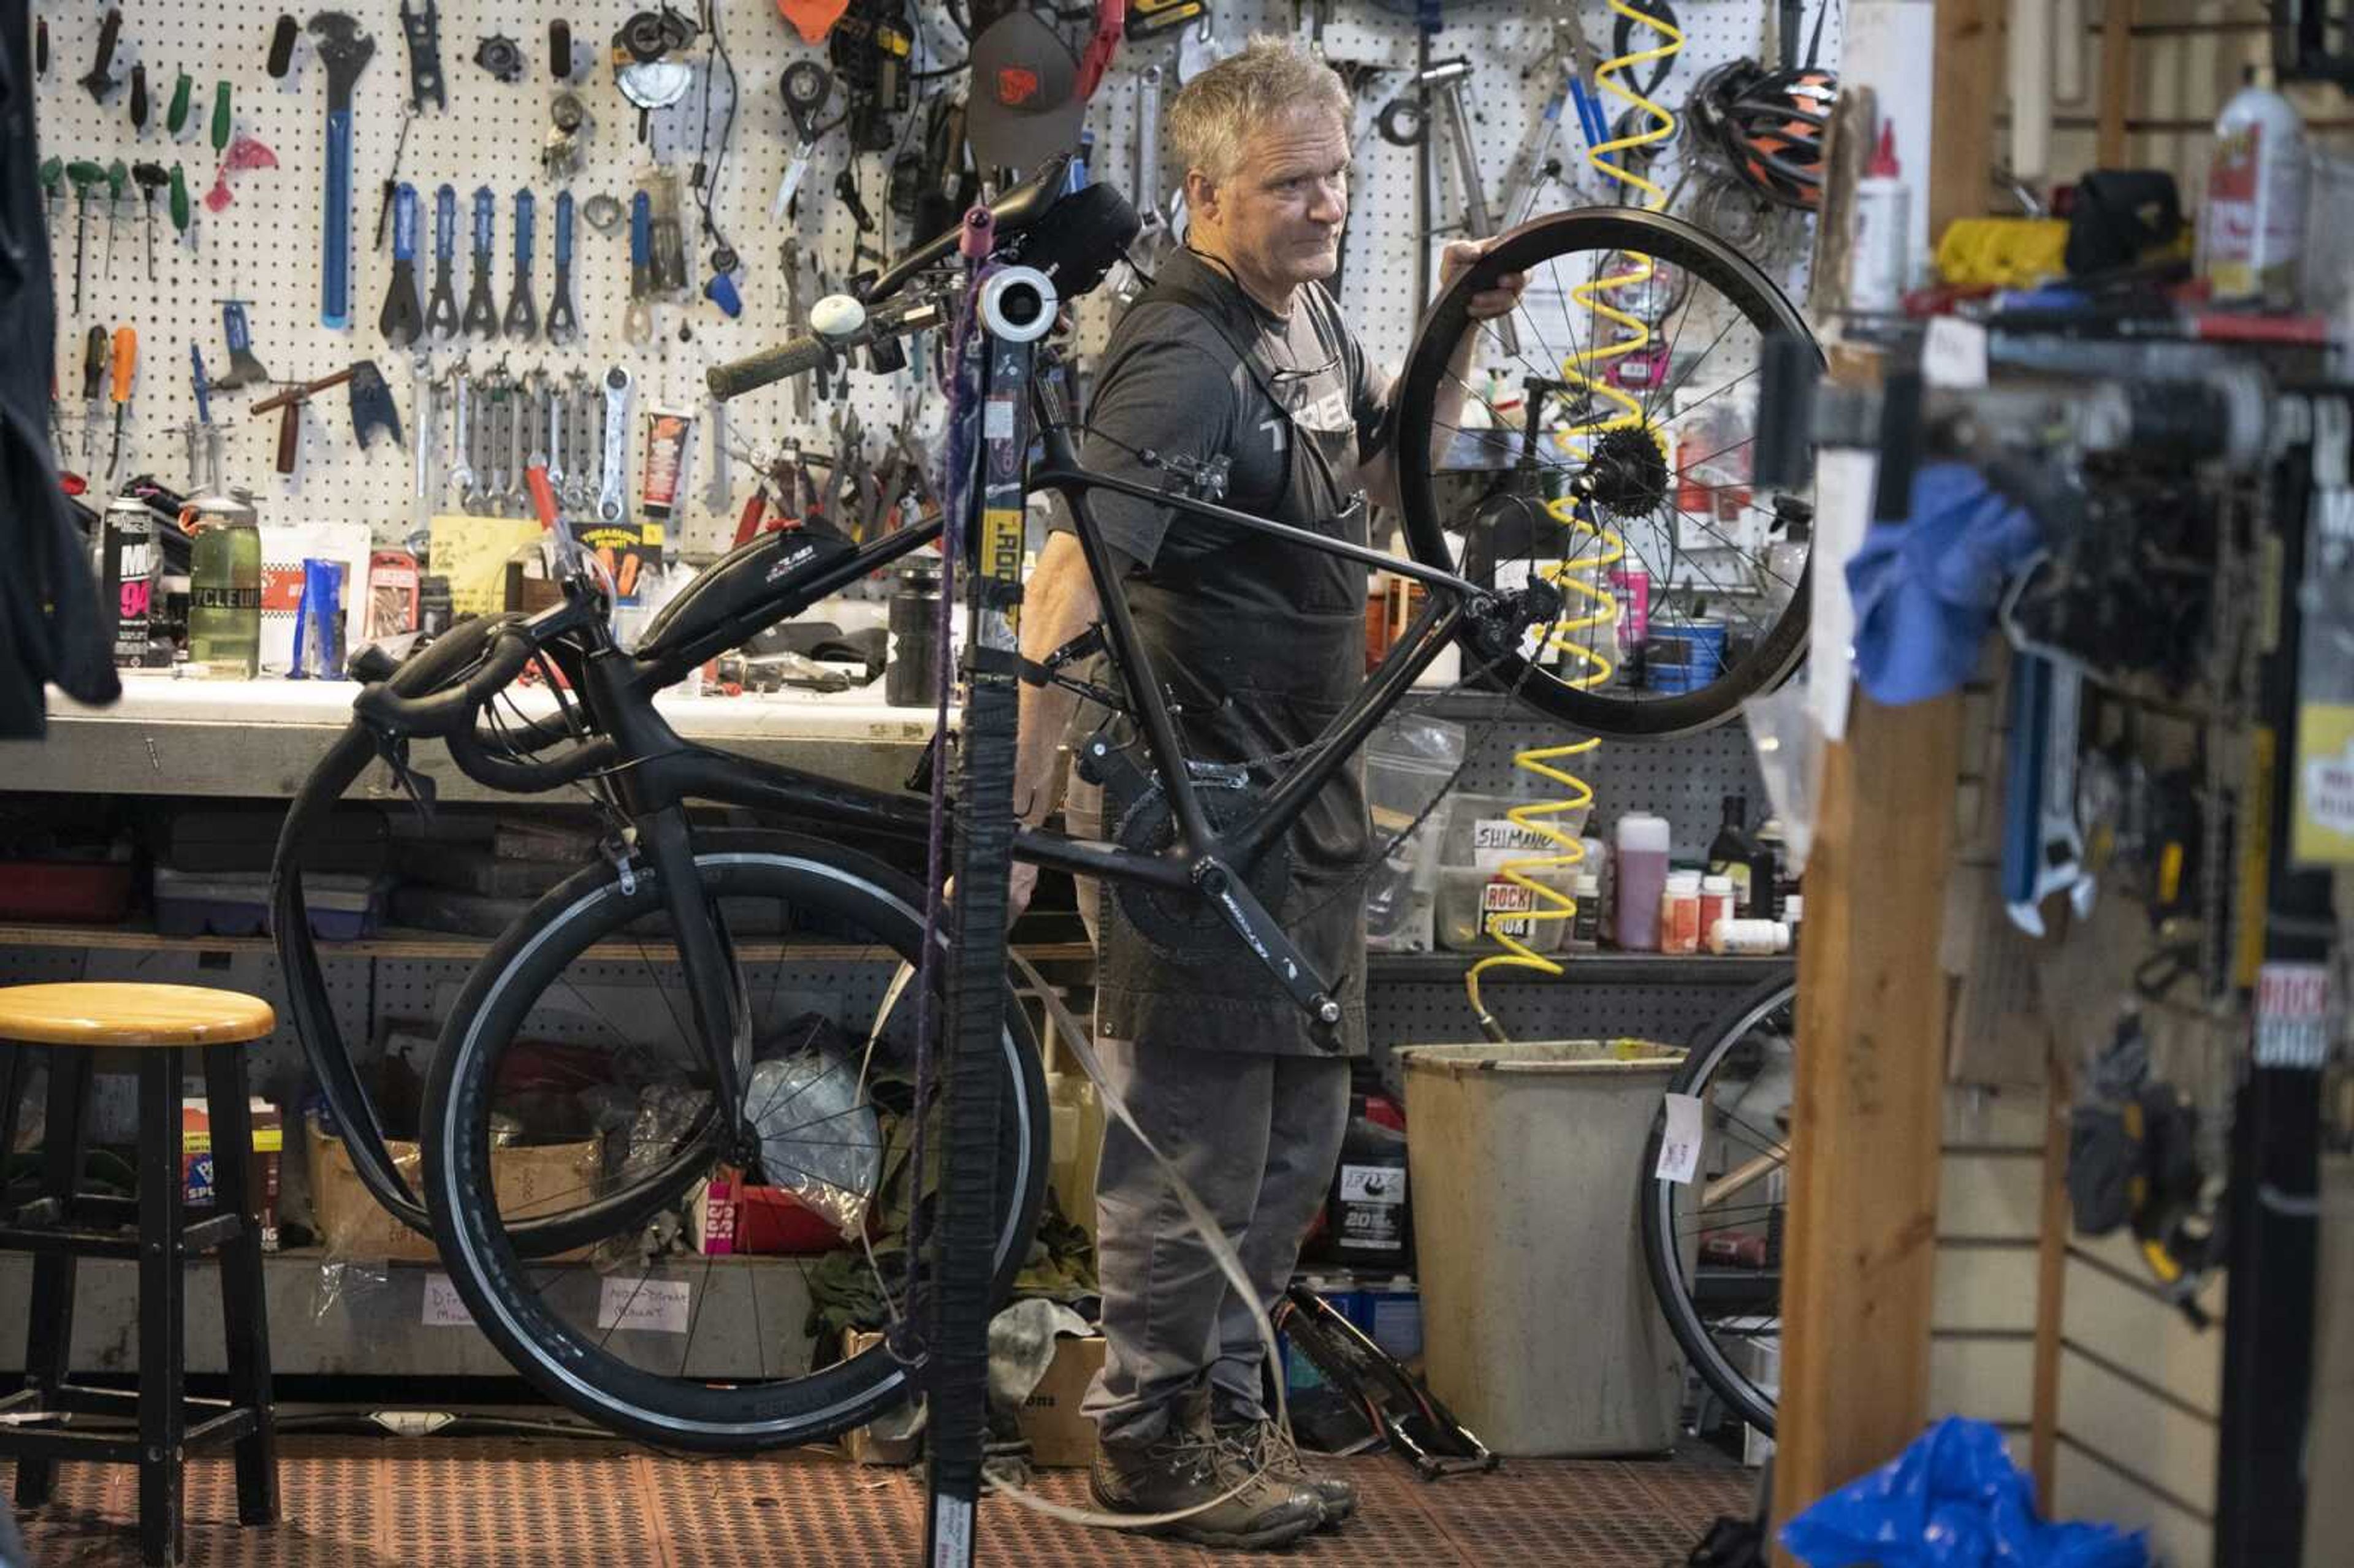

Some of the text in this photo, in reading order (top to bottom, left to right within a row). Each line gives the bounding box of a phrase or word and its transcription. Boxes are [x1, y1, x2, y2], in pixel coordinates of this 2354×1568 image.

[1488, 887, 1528, 908] ROCK
[1345, 1211, 1371, 1227] 20
[262, 1228, 278, 1241] 16
